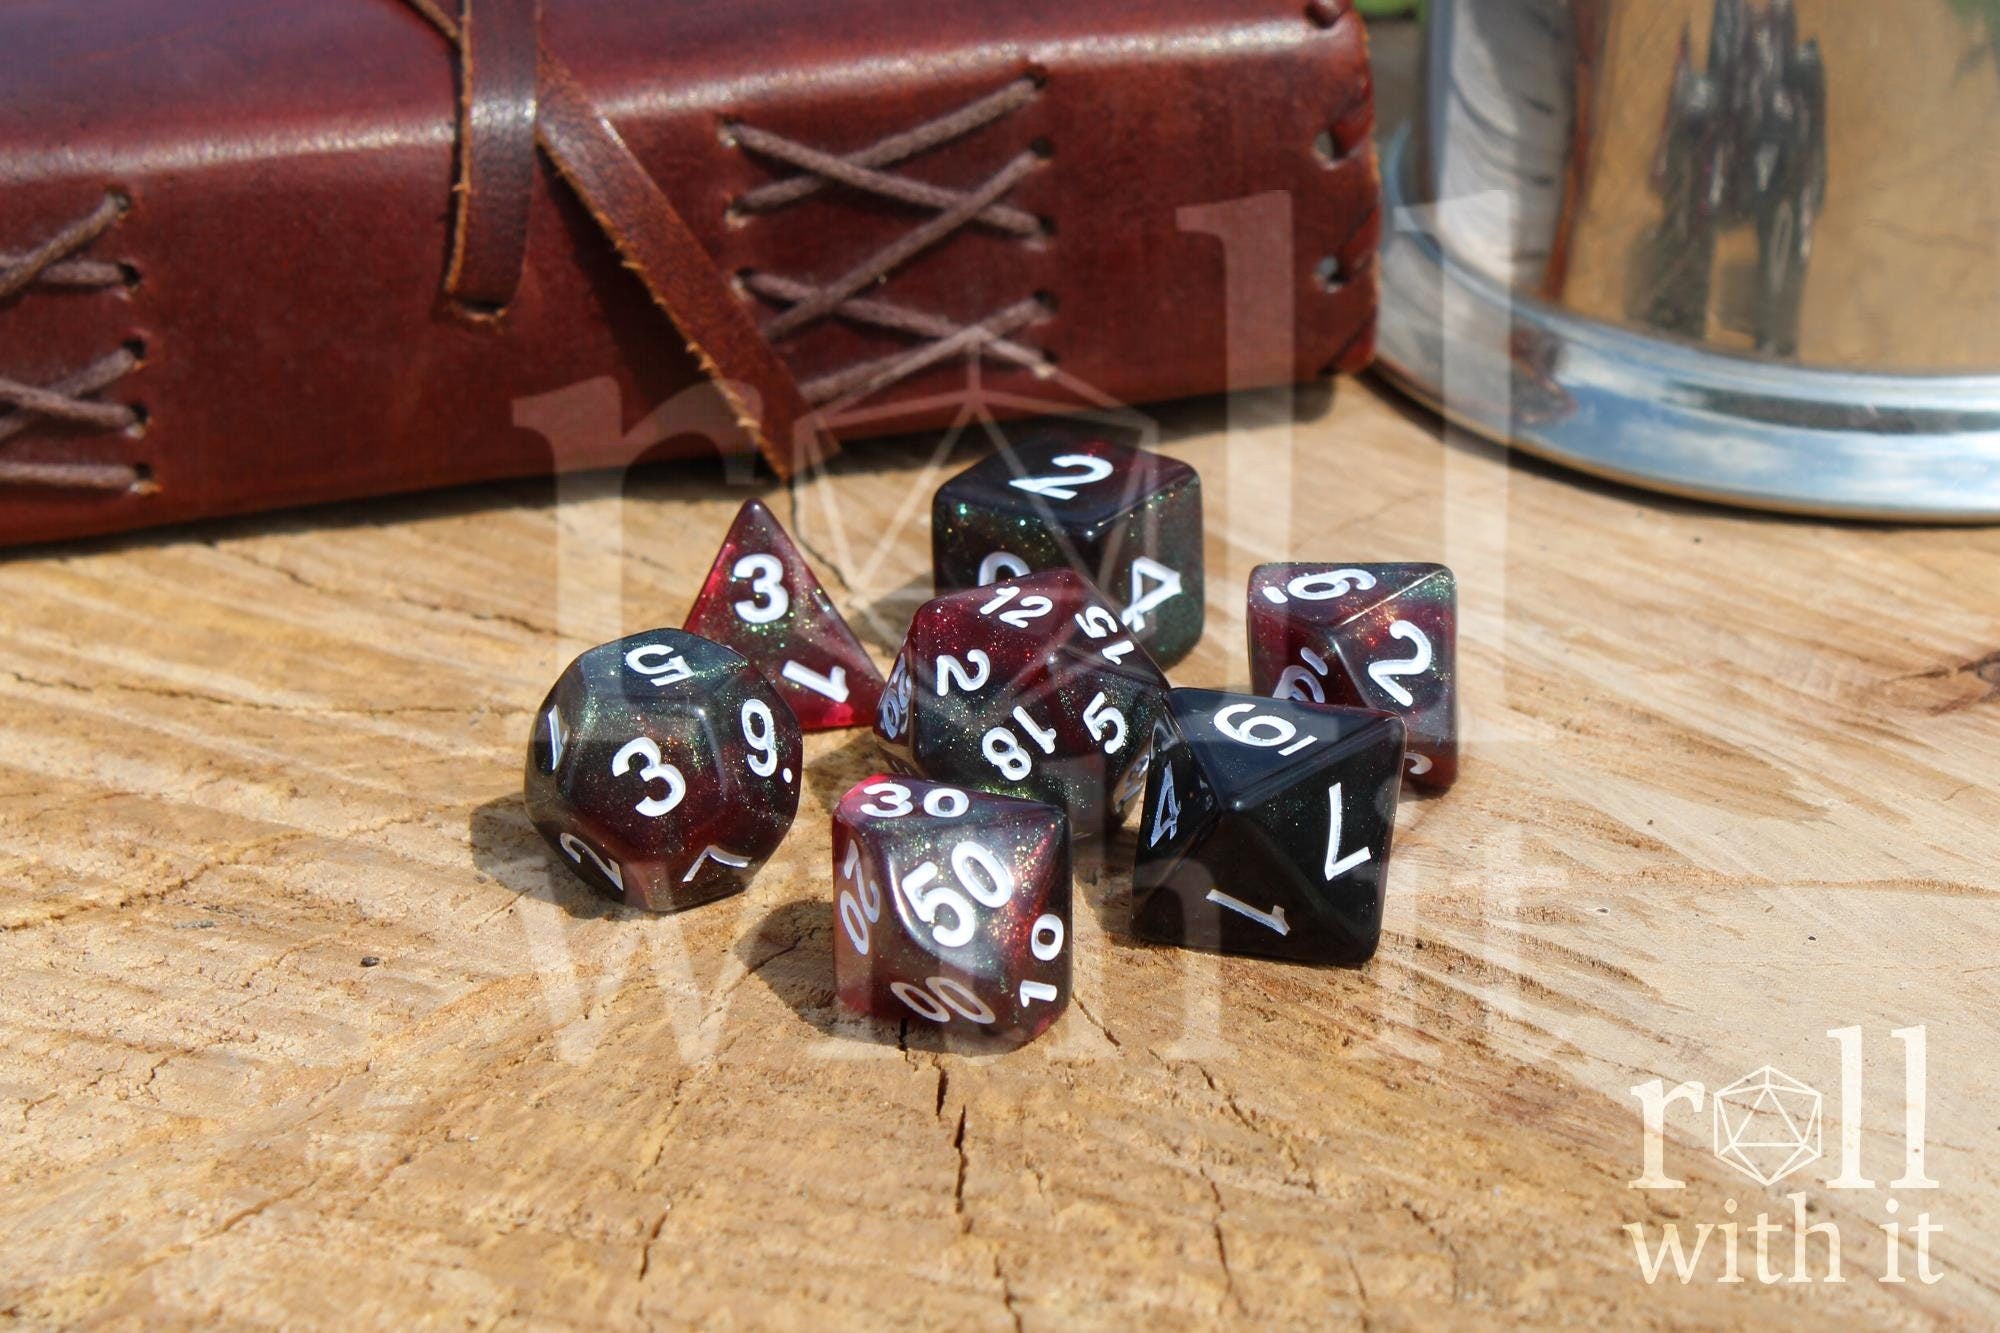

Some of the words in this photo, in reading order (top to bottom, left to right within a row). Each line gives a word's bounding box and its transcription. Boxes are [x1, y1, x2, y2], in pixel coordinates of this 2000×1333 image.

[1009, 454, 1113, 500] 2
[733, 553, 789, 624] 3
[979, 586, 1053, 628] 12
[1121, 556, 1182, 632] 4
[626, 644, 695, 686] 5
[1074, 606, 1135, 665] 15
[1368, 620, 1432, 707] 2
[782, 660, 849, 703] 1
[936, 649, 990, 696] 2
[982, 706, 1056, 781] 18
[1082, 692, 1126, 754] 5
[612, 737, 686, 817] 3
[861, 783, 969, 817] 30
[1150, 760, 1181, 848] 4
[1324, 782, 1371, 881] 7
[560, 833, 623, 891] 2
[840, 839, 880, 955] 20
[901, 841, 1015, 948] 50
[1206, 888, 1290, 936] 1
[890, 976, 996, 1024] 00
